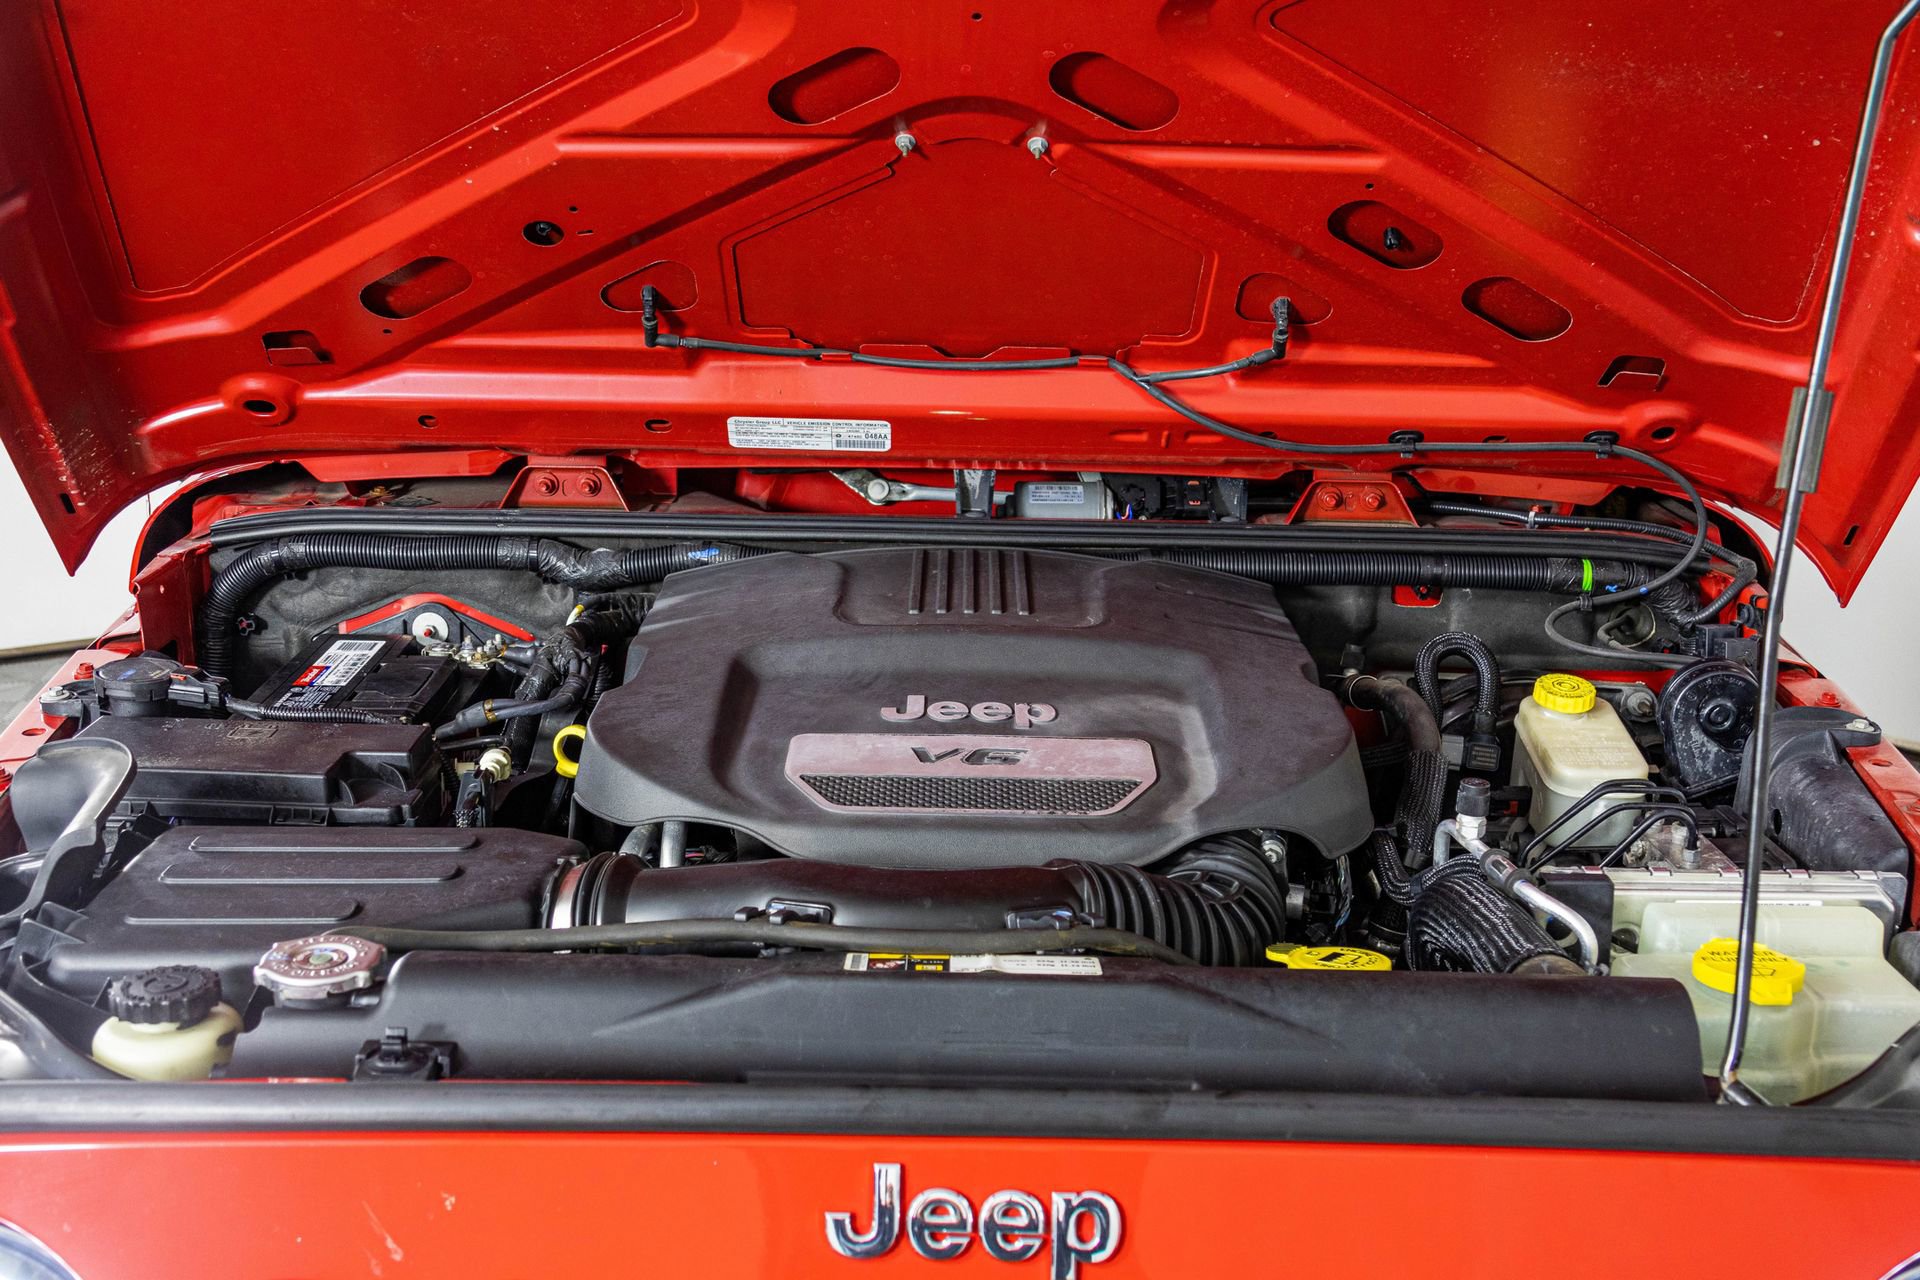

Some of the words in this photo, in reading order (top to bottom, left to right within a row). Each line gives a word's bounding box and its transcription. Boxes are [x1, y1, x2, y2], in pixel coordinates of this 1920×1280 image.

[880, 694, 1058, 730] Jeep
[911, 746, 1030, 766] V6
[1706, 950, 1777, 958] WASER
[824, 1162, 1122, 1280] Jeep
